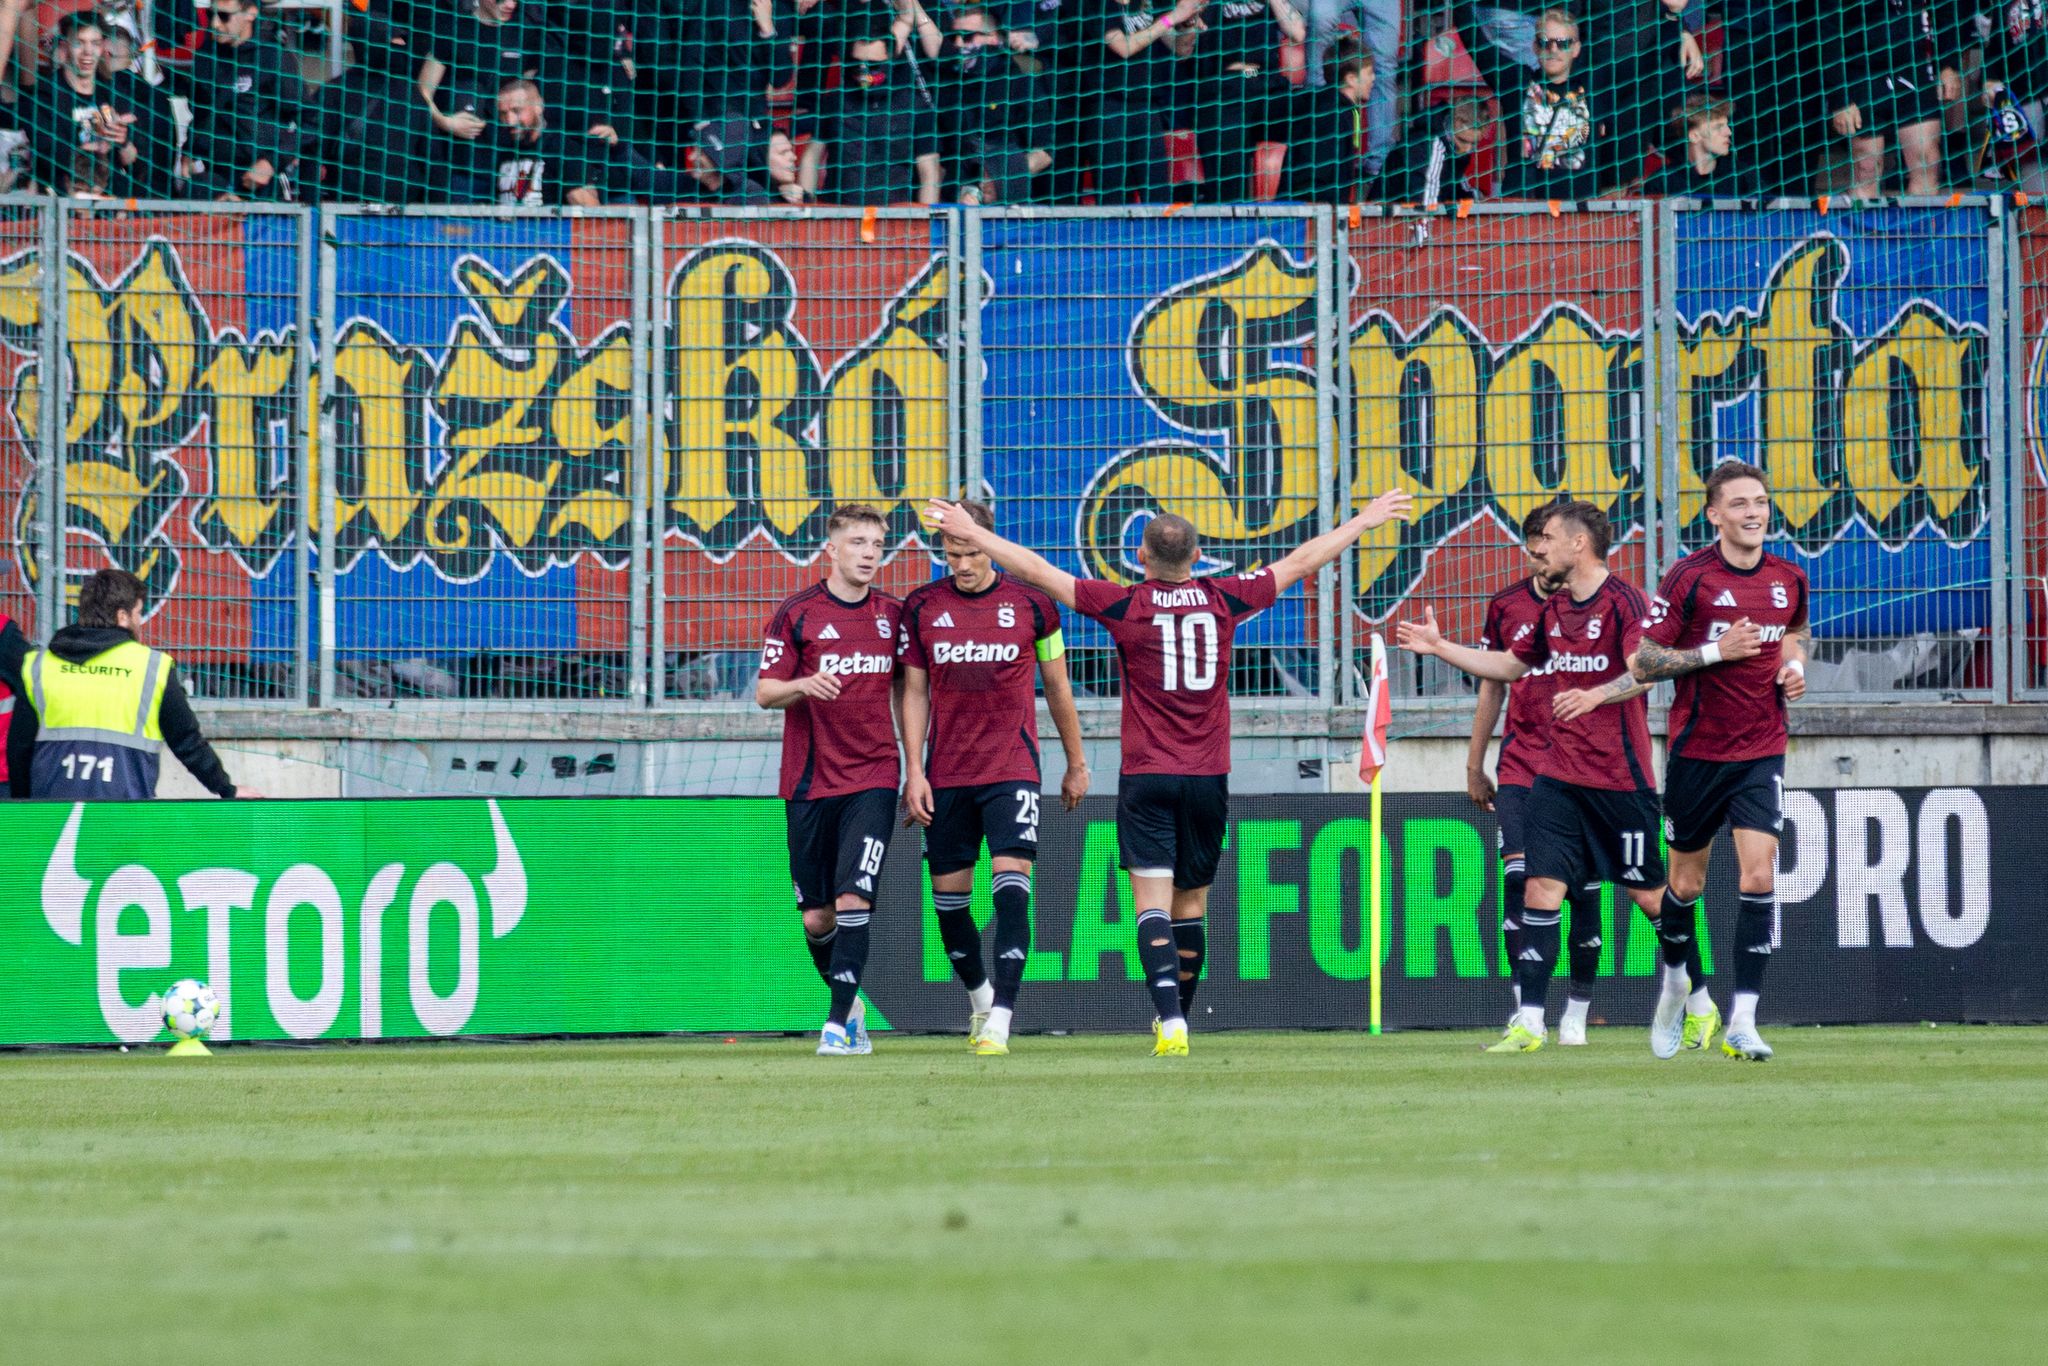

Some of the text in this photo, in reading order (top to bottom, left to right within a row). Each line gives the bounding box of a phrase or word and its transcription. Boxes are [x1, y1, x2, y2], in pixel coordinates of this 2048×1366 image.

[1078, 232, 1992, 622] Sparta
[1152, 587, 1208, 608] KUCHTA
[819, 652, 892, 676] Betano
[933, 640, 1020, 664] Betano
[1152, 612, 1218, 691] 10
[60, 664, 133, 678] SECURITY
[61, 754, 114, 783] 171
[1015, 789, 1040, 826] 25
[859, 836, 885, 876] 19
[1621, 831, 1645, 866] 11
[1769, 786, 1992, 948] PRO
